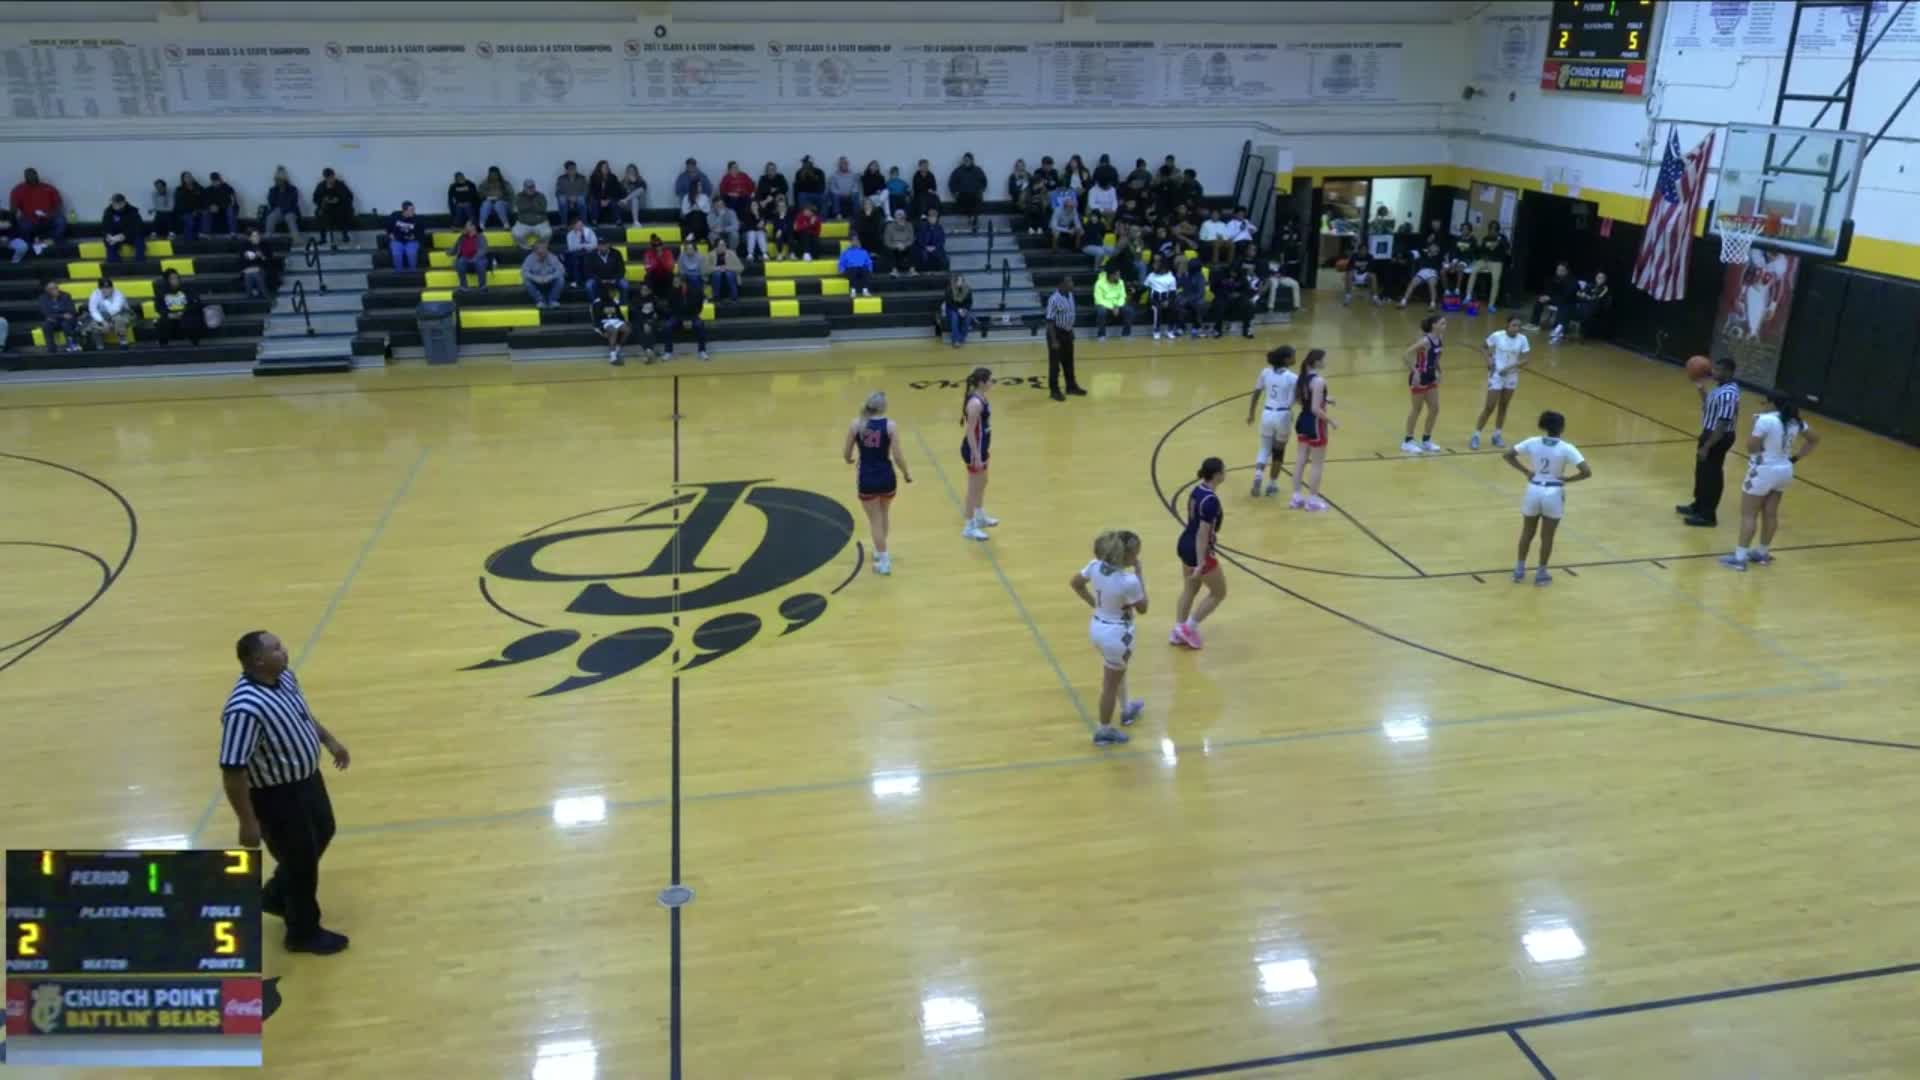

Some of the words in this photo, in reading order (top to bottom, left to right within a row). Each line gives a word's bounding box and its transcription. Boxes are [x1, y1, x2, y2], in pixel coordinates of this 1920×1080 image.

[1559, 31, 1569, 49] 2
[1628, 31, 1639, 50] 5
[1540, 457, 1550, 474] 2
